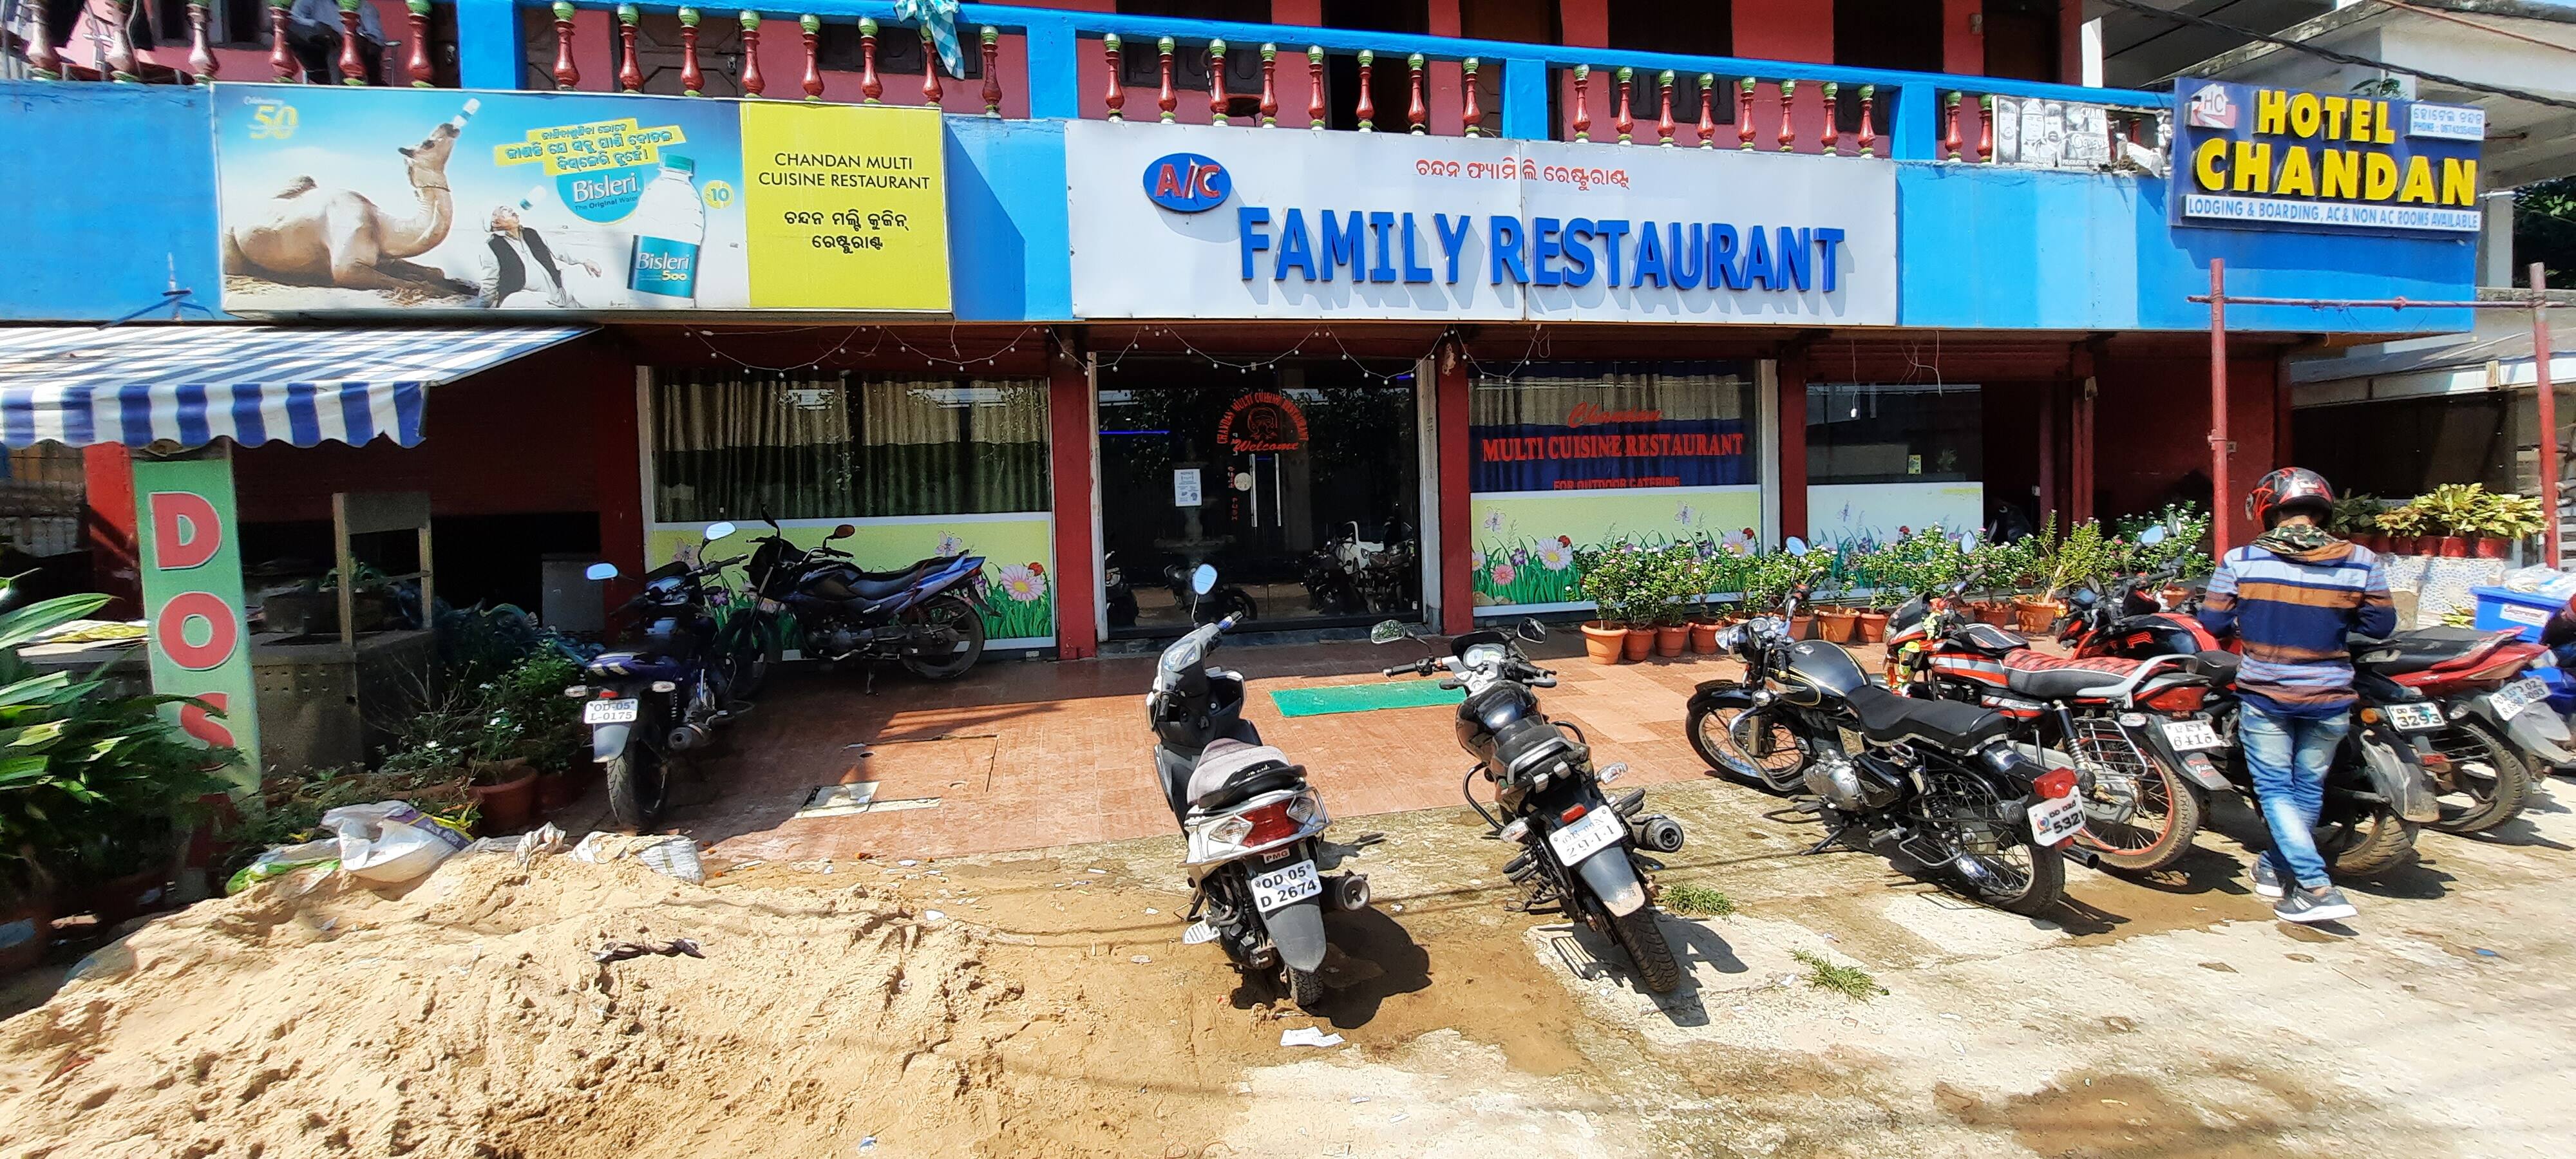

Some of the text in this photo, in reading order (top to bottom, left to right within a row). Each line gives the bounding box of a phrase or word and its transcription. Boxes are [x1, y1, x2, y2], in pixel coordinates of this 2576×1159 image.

[2204, 92, 2224, 112] HC
[249, 105, 299, 139] 50
[2257, 89, 2396, 144] HOTEL
[547, 142, 567, 155] ଯେ
[571, 139, 594, 153] ସବୁ
[598, 133, 624, 149] ପାଣି
[627, 130, 672, 146] ବୋତଲ
[774, 153, 913, 170] CHANDAN MULTI
[1416, 159, 1461, 178] ଚନ୍ଦନ
[2195, 137, 2477, 207] CHANDAN
[573, 172, 639, 203] Bisleri
[759, 172, 930, 189] CUISINE RESTAURANT
[1155, 161, 1221, 200] A/C
[574, 195, 639, 212] The Original Water
[2189, 197, 2243, 216] LODGING
[2247, 202, 2254, 216] &
[2326, 206, 2341, 221] AC
[2342, 207, 2349, 222] &
[2352, 207, 2376, 223] NON
[2398, 210, 2429, 227] ROOMS
[2431, 213, 2477, 229] AVAILABLE
[784, 209, 909, 232] ଚନ୍ଦନ ମଲ୍ଟି କୁଜିନ୍
[1238, 206, 1846, 293] FAMILY RESTAURANT
[636, 252, 690, 270] Bisleri
[661, 270, 688, 281] 500
[1231, 393, 1254, 411] MULTI
[1567, 401, 1663, 428] Chandan
[1231, 438, 1300, 452] Welcome
[1482, 432, 1745, 463] MULTI CUISINE RESTAURANT
[1553, 476, 1680, 491] FOR OUTDOOR CATERING
[590, 711, 632, 721] L-0175
[594, 702, 631, 712] OD-05
[2396, 713, 2442, 728] 3293
[2053, 809, 2085, 834] 5321
[1266, 851, 1289, 862] PMG
[1262, 866, 1306, 889] OD 05
[1260, 879, 1317, 908] D 2674
